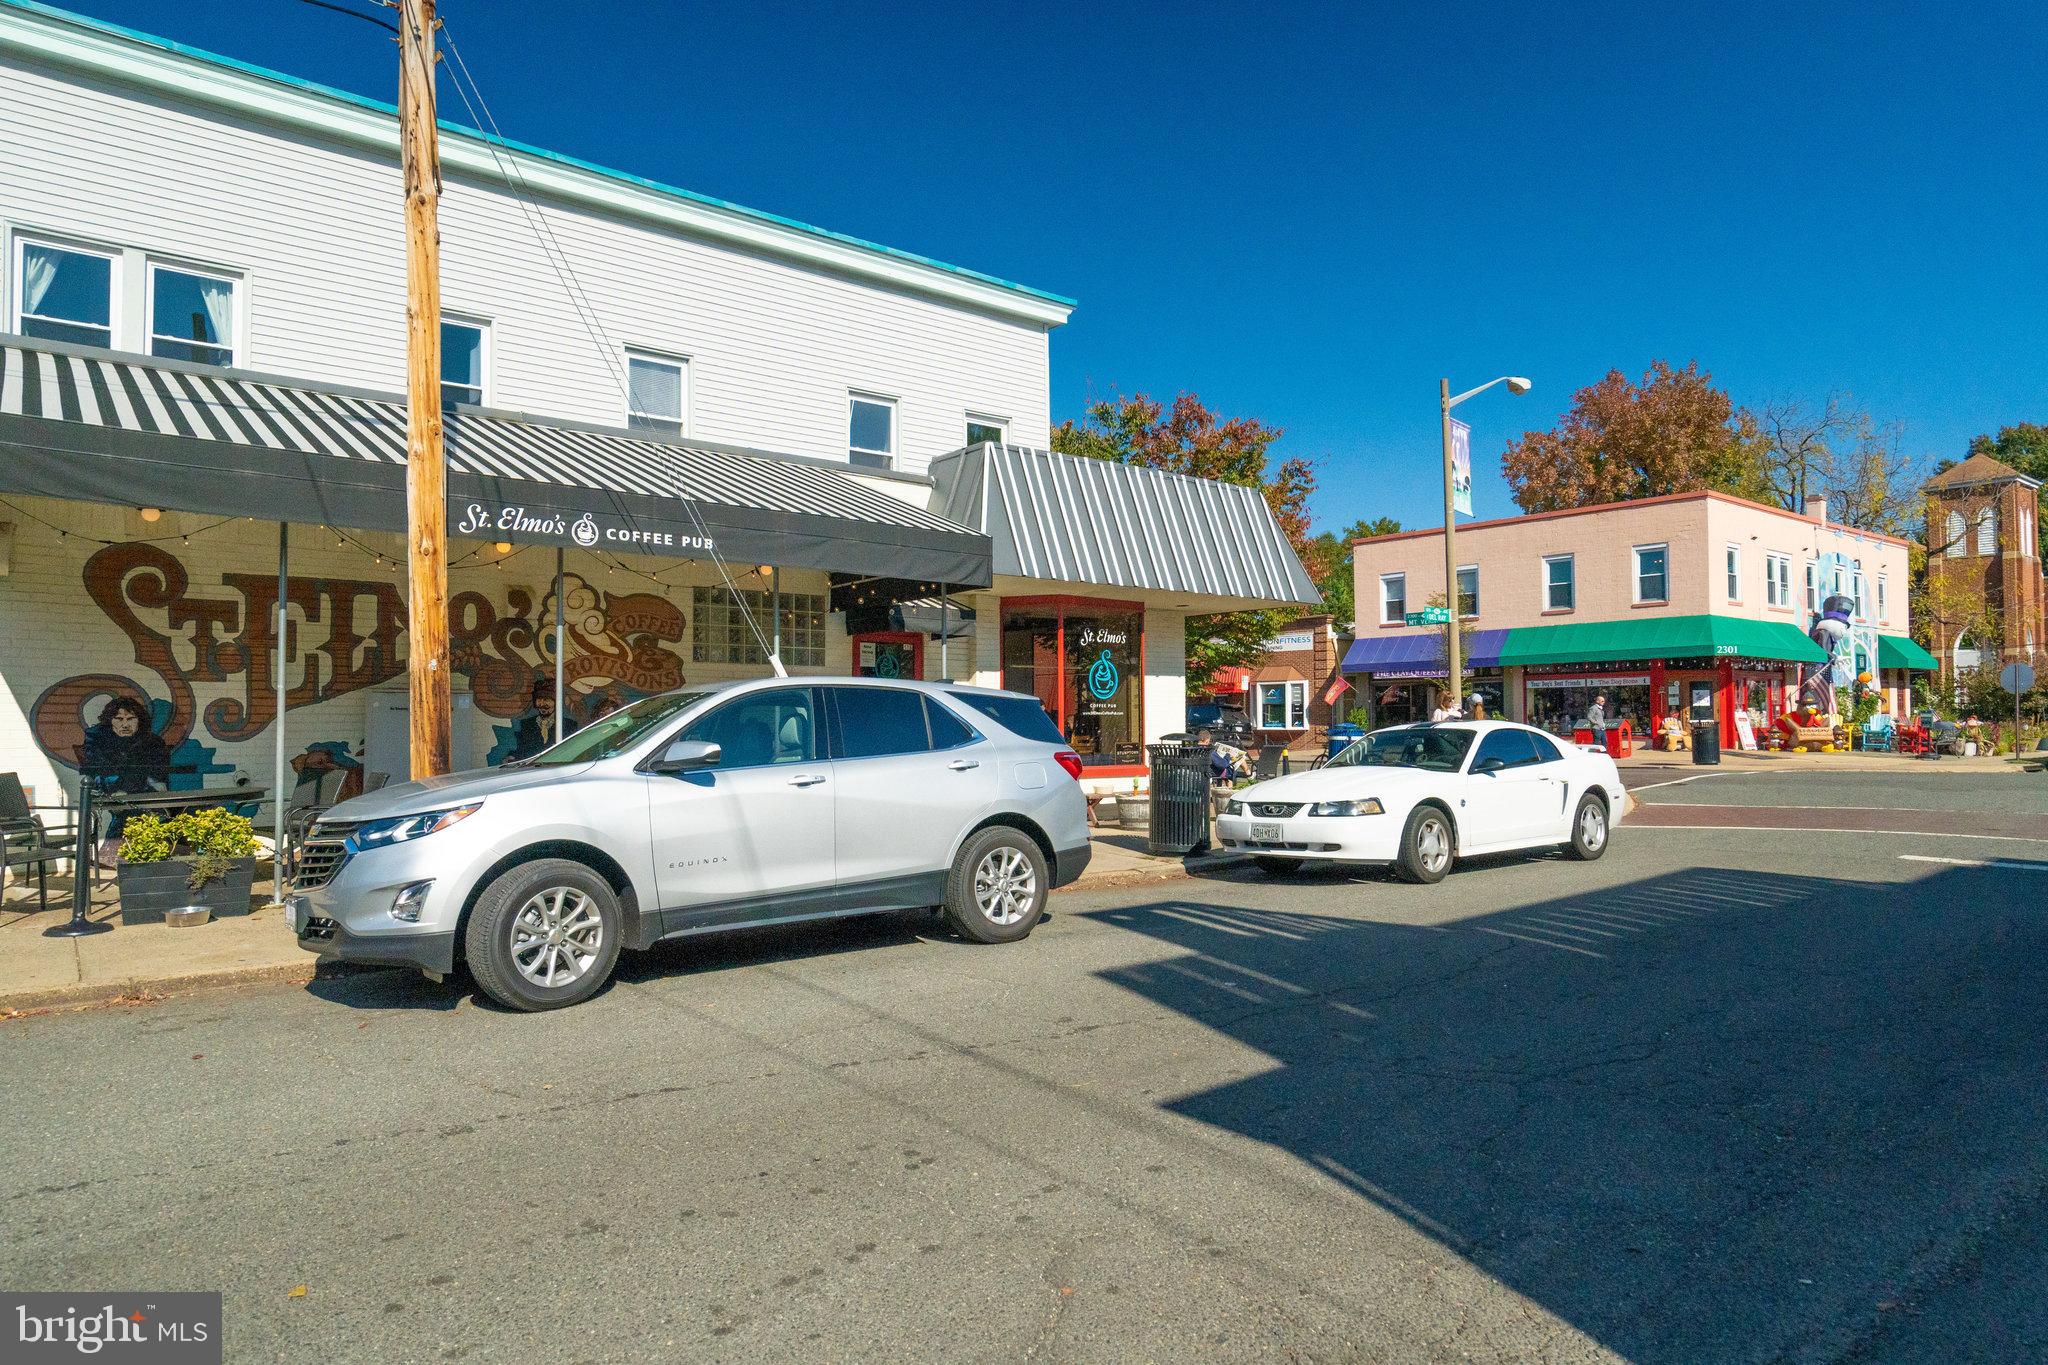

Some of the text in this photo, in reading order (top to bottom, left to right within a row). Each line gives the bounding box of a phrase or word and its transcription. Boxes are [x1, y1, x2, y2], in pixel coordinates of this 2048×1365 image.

[459, 504, 565, 535] St. Elmo's
[606, 528, 715, 550] COFFEE PUB
[612, 612, 680, 635] COFFEE
[1081, 628, 1127, 646] St. Elmo's
[1717, 645, 1738, 654] 2301
[556, 655, 679, 690] ROVISIONS
[669, 857, 728, 868] EQUINOX
